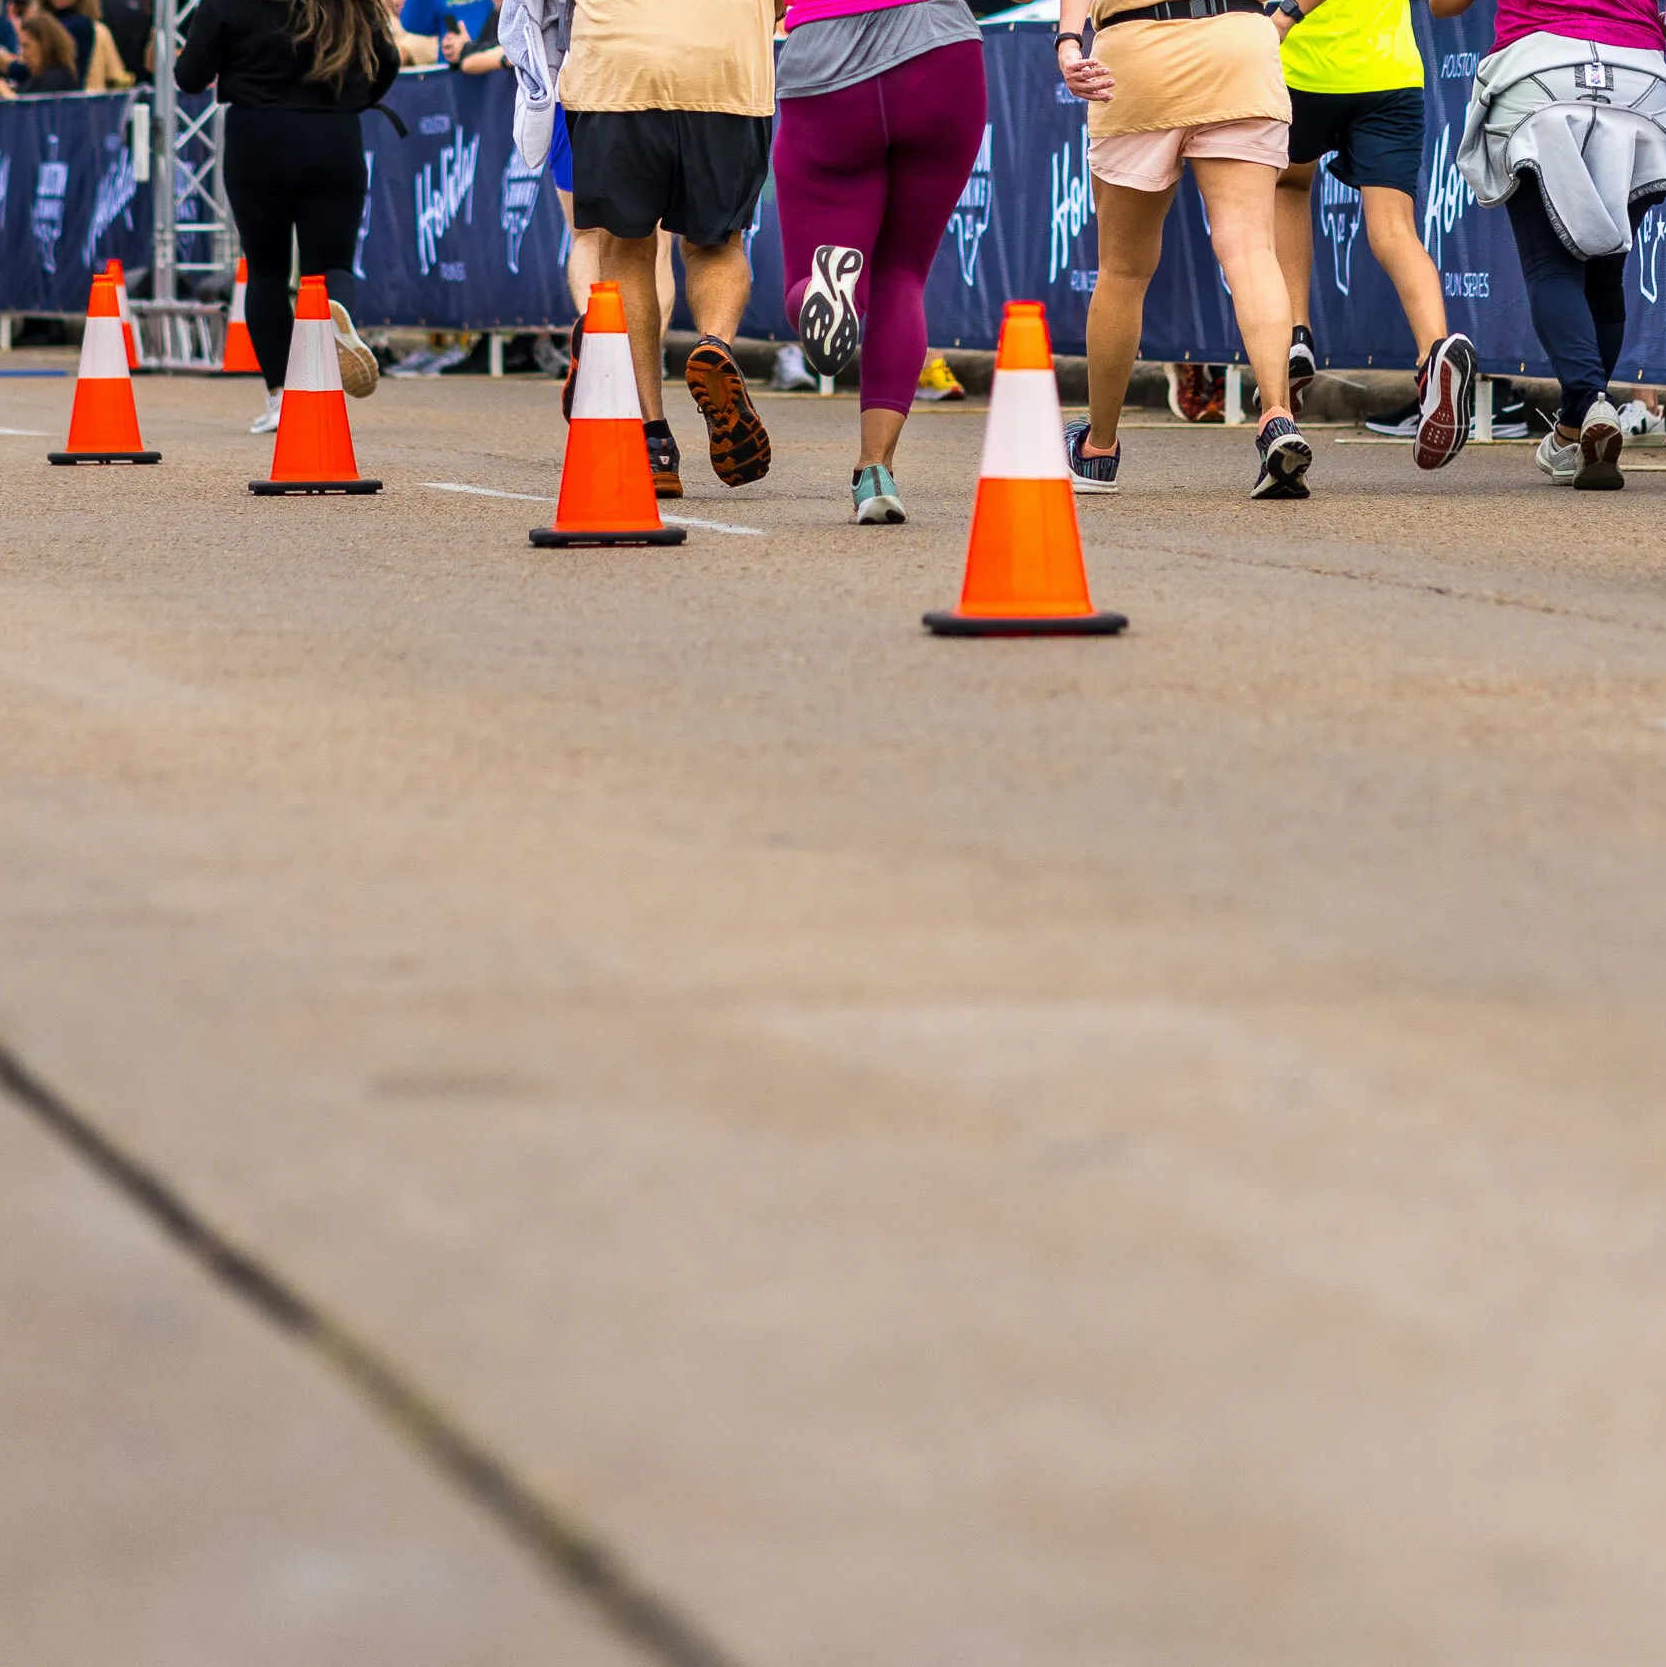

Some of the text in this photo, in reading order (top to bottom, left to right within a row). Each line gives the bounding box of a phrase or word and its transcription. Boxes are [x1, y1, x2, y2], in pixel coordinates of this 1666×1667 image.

[1441, 52, 1479, 79] HOUSTON
[1445, 272, 1489, 298] RUN SERIES
